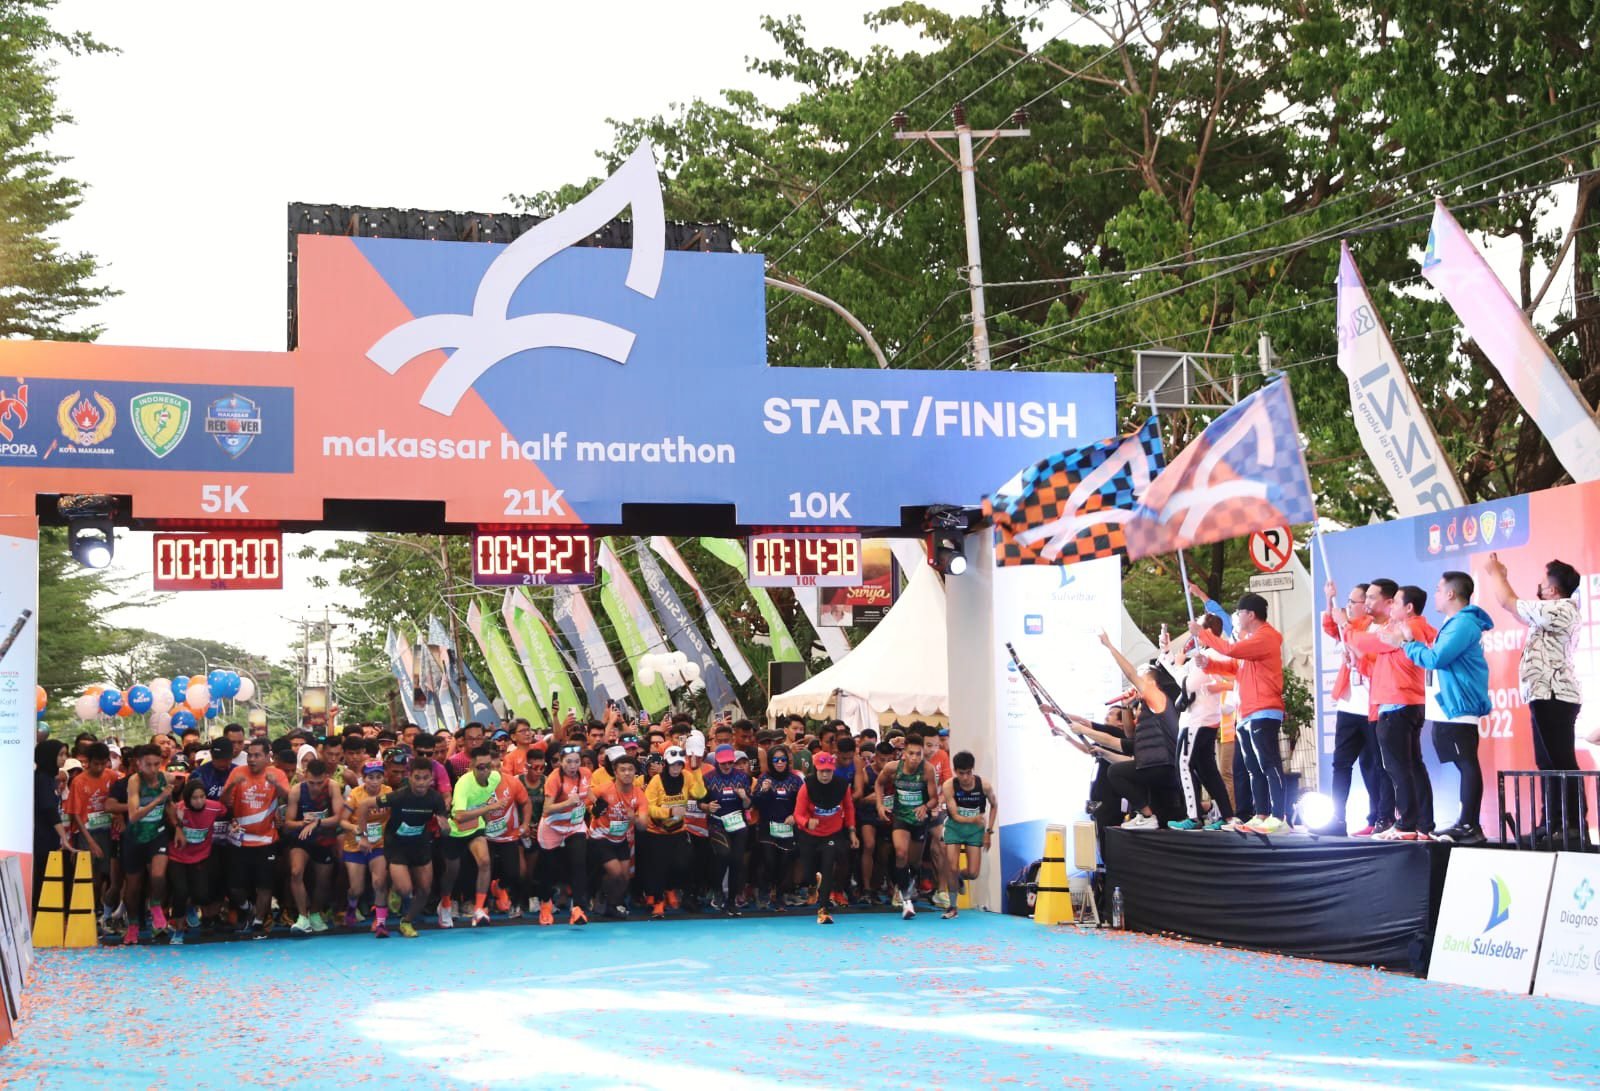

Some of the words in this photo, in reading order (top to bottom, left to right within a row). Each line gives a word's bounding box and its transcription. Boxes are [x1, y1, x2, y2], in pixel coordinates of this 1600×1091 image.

[139, 396, 182, 406] INDONESIA
[763, 396, 1077, 438] START/FINISH
[0, 444, 37, 454] PORA
[322, 430, 491, 460] makassar
[501, 432, 567, 461] half
[576, 436, 736, 464] marathon
[200, 485, 249, 513] 5K
[503, 489, 565, 517] 21K
[788, 493, 851, 519] 10K
[157, 539, 279, 580] 00:00:00
[477, 535, 591, 576] 00:43:27
[752, 538, 858, 577] 00:14:38
[211, 580, 226, 589] 5K
[523, 574, 547, 585] 21K
[796, 576, 817, 586] 10K
[847, 586, 890, 604] Surya
[1480, 709, 1514, 738] 022
[1560, 910, 1598, 928] Diagnos
